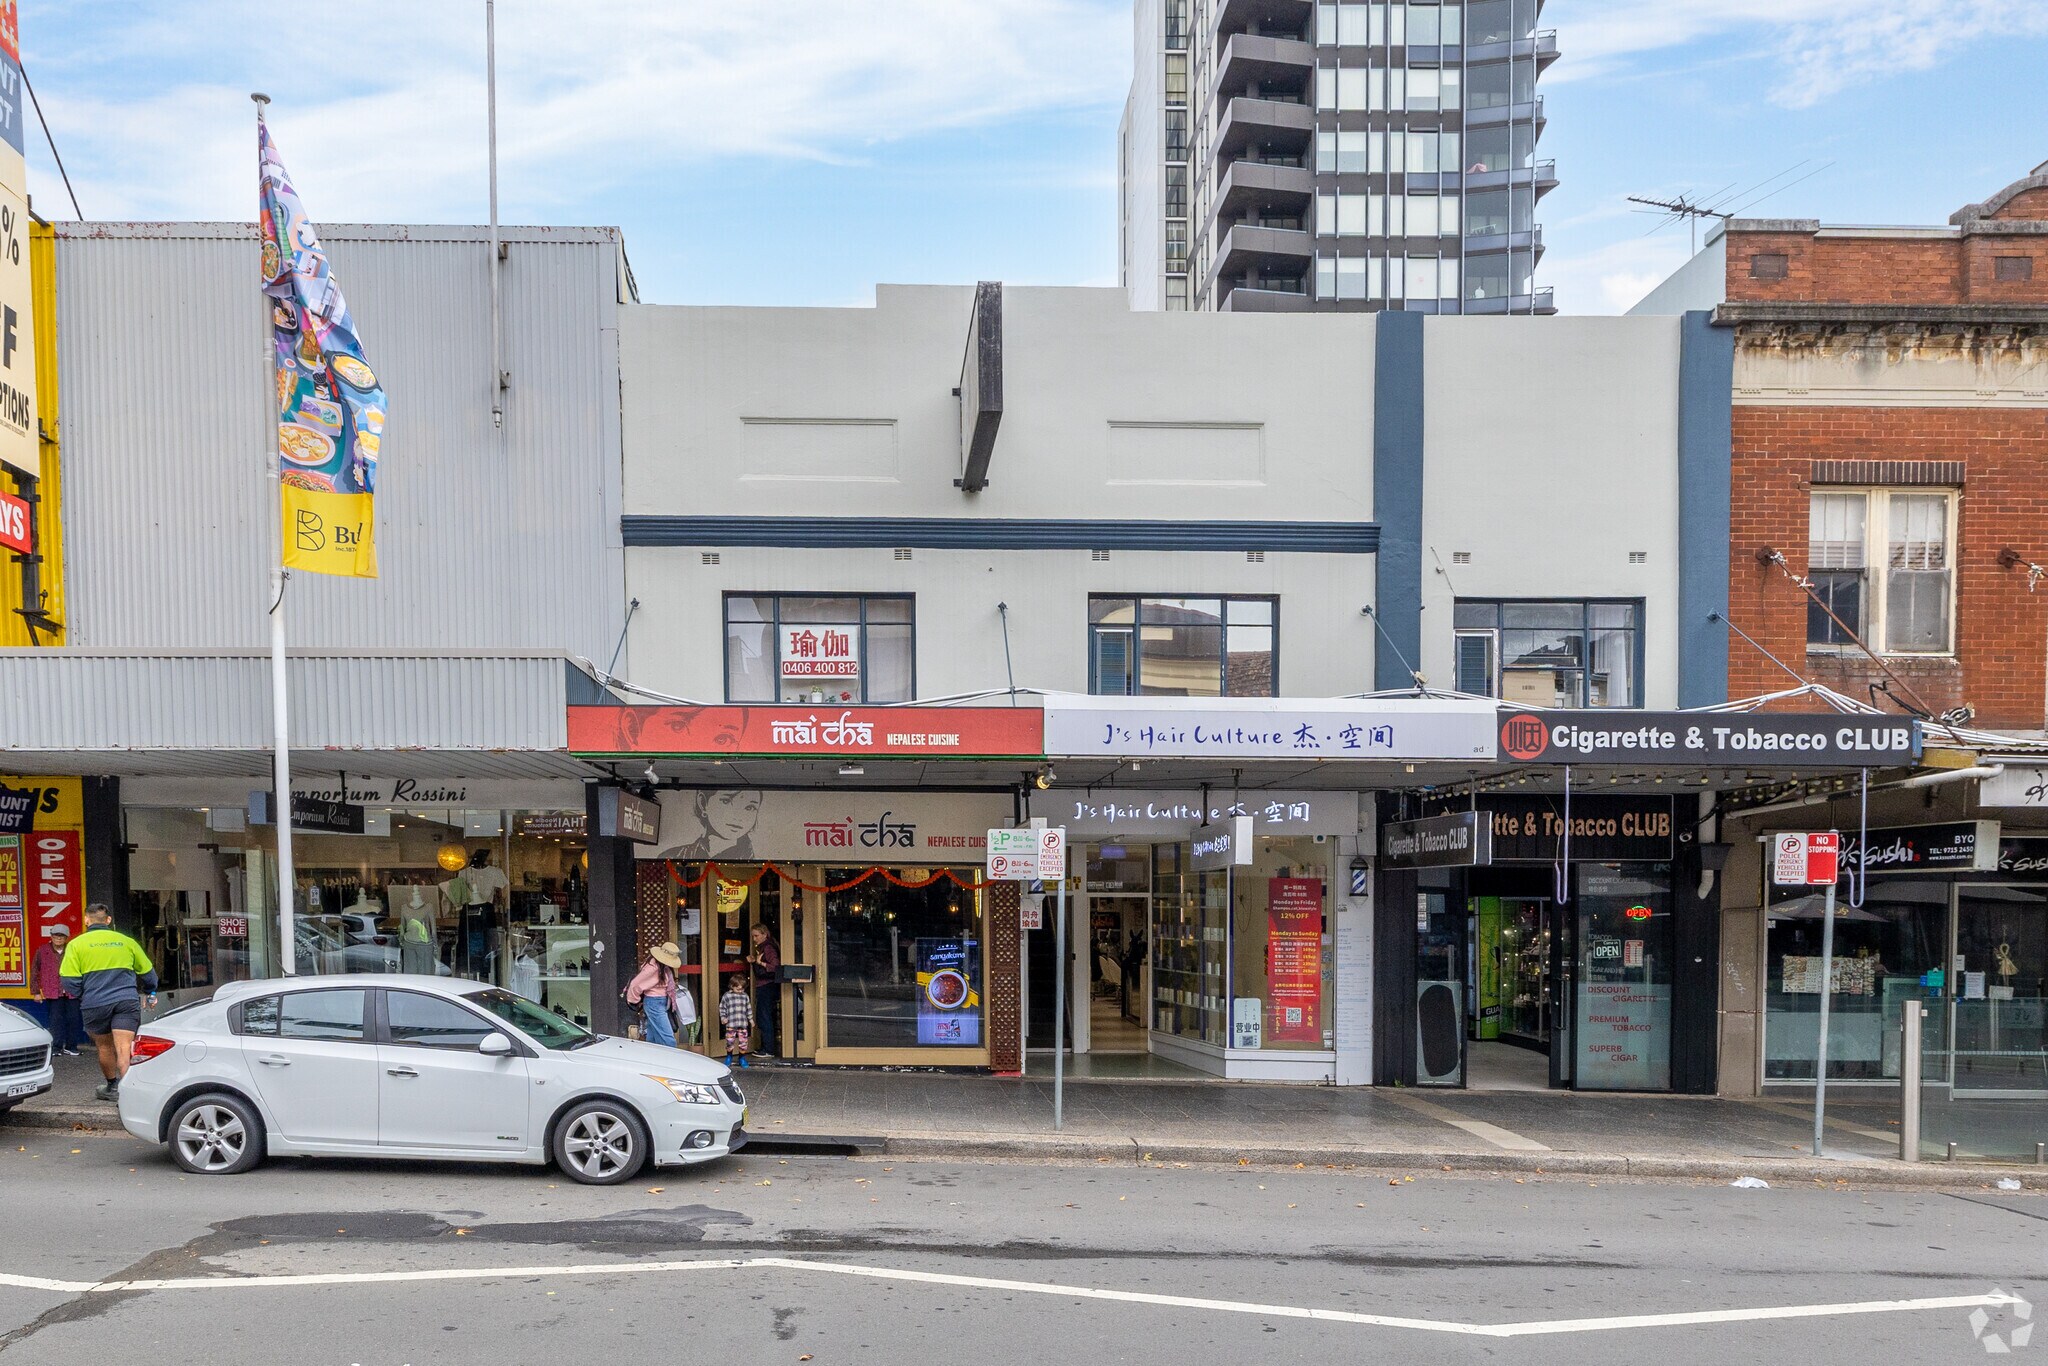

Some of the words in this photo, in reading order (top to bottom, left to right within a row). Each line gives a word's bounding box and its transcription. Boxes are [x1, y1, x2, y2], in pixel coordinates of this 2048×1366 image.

[790, 630, 849, 657] 瑜伽
[783, 662, 811, 674] 0406
[814, 662, 835, 674] 400
[838, 662, 857, 674] 812
[771, 714, 817, 745] mai
[821, 711, 874, 745] cha
[887, 734, 926, 746] NEPALESE
[928, 734, 960, 746] CUISINE
[1102, 724, 1132, 744] J's
[1140, 725, 1185, 749] Hair
[1194, 725, 1284, 744] Culture
[1551, 725, 1676, 753] Cigarette
[1684, 727, 1705, 749] &
[1712, 728, 1828, 750] Tobacco
[1835, 728, 1910, 750] CLUB
[289, 779, 381, 801] mporium
[390, 778, 467, 802] Rossini
[0, 812, 23, 827] IST
[326, 804, 351, 826] Rossini
[1074, 802, 1098, 819] J's
[1104, 803, 1142, 823] Hair
[1147, 802, 1220, 819] Cultue
[803, 816, 853, 847] mai
[858, 811, 916, 847] cha
[927, 836, 966, 848] NEPALESE
[968, 836, 987, 848] CUIS
[1490, 813, 1519, 836] tte
[1524, 812, 1537, 836] &
[1542, 812, 1617, 837] Tobacco
[1621, 812, 1671, 837] CLUB
[1388, 836, 1414, 859] Cigarette
[1414, 833, 1420, 853] &
[1421, 831, 1448, 852] Tobacco
[1449, 827, 1468, 849] CLUB
[1816, 836, 1828, 844] NO
[1954, 834, 1974, 844] BYO
[220, 918, 246, 926] SHOE
[1626, 908, 1652, 918] OPEN
[220, 927, 246, 935] SALE
[1596, 946, 1619, 957] OPEN
[1236, 1022, 1260, 1033] 营业中
